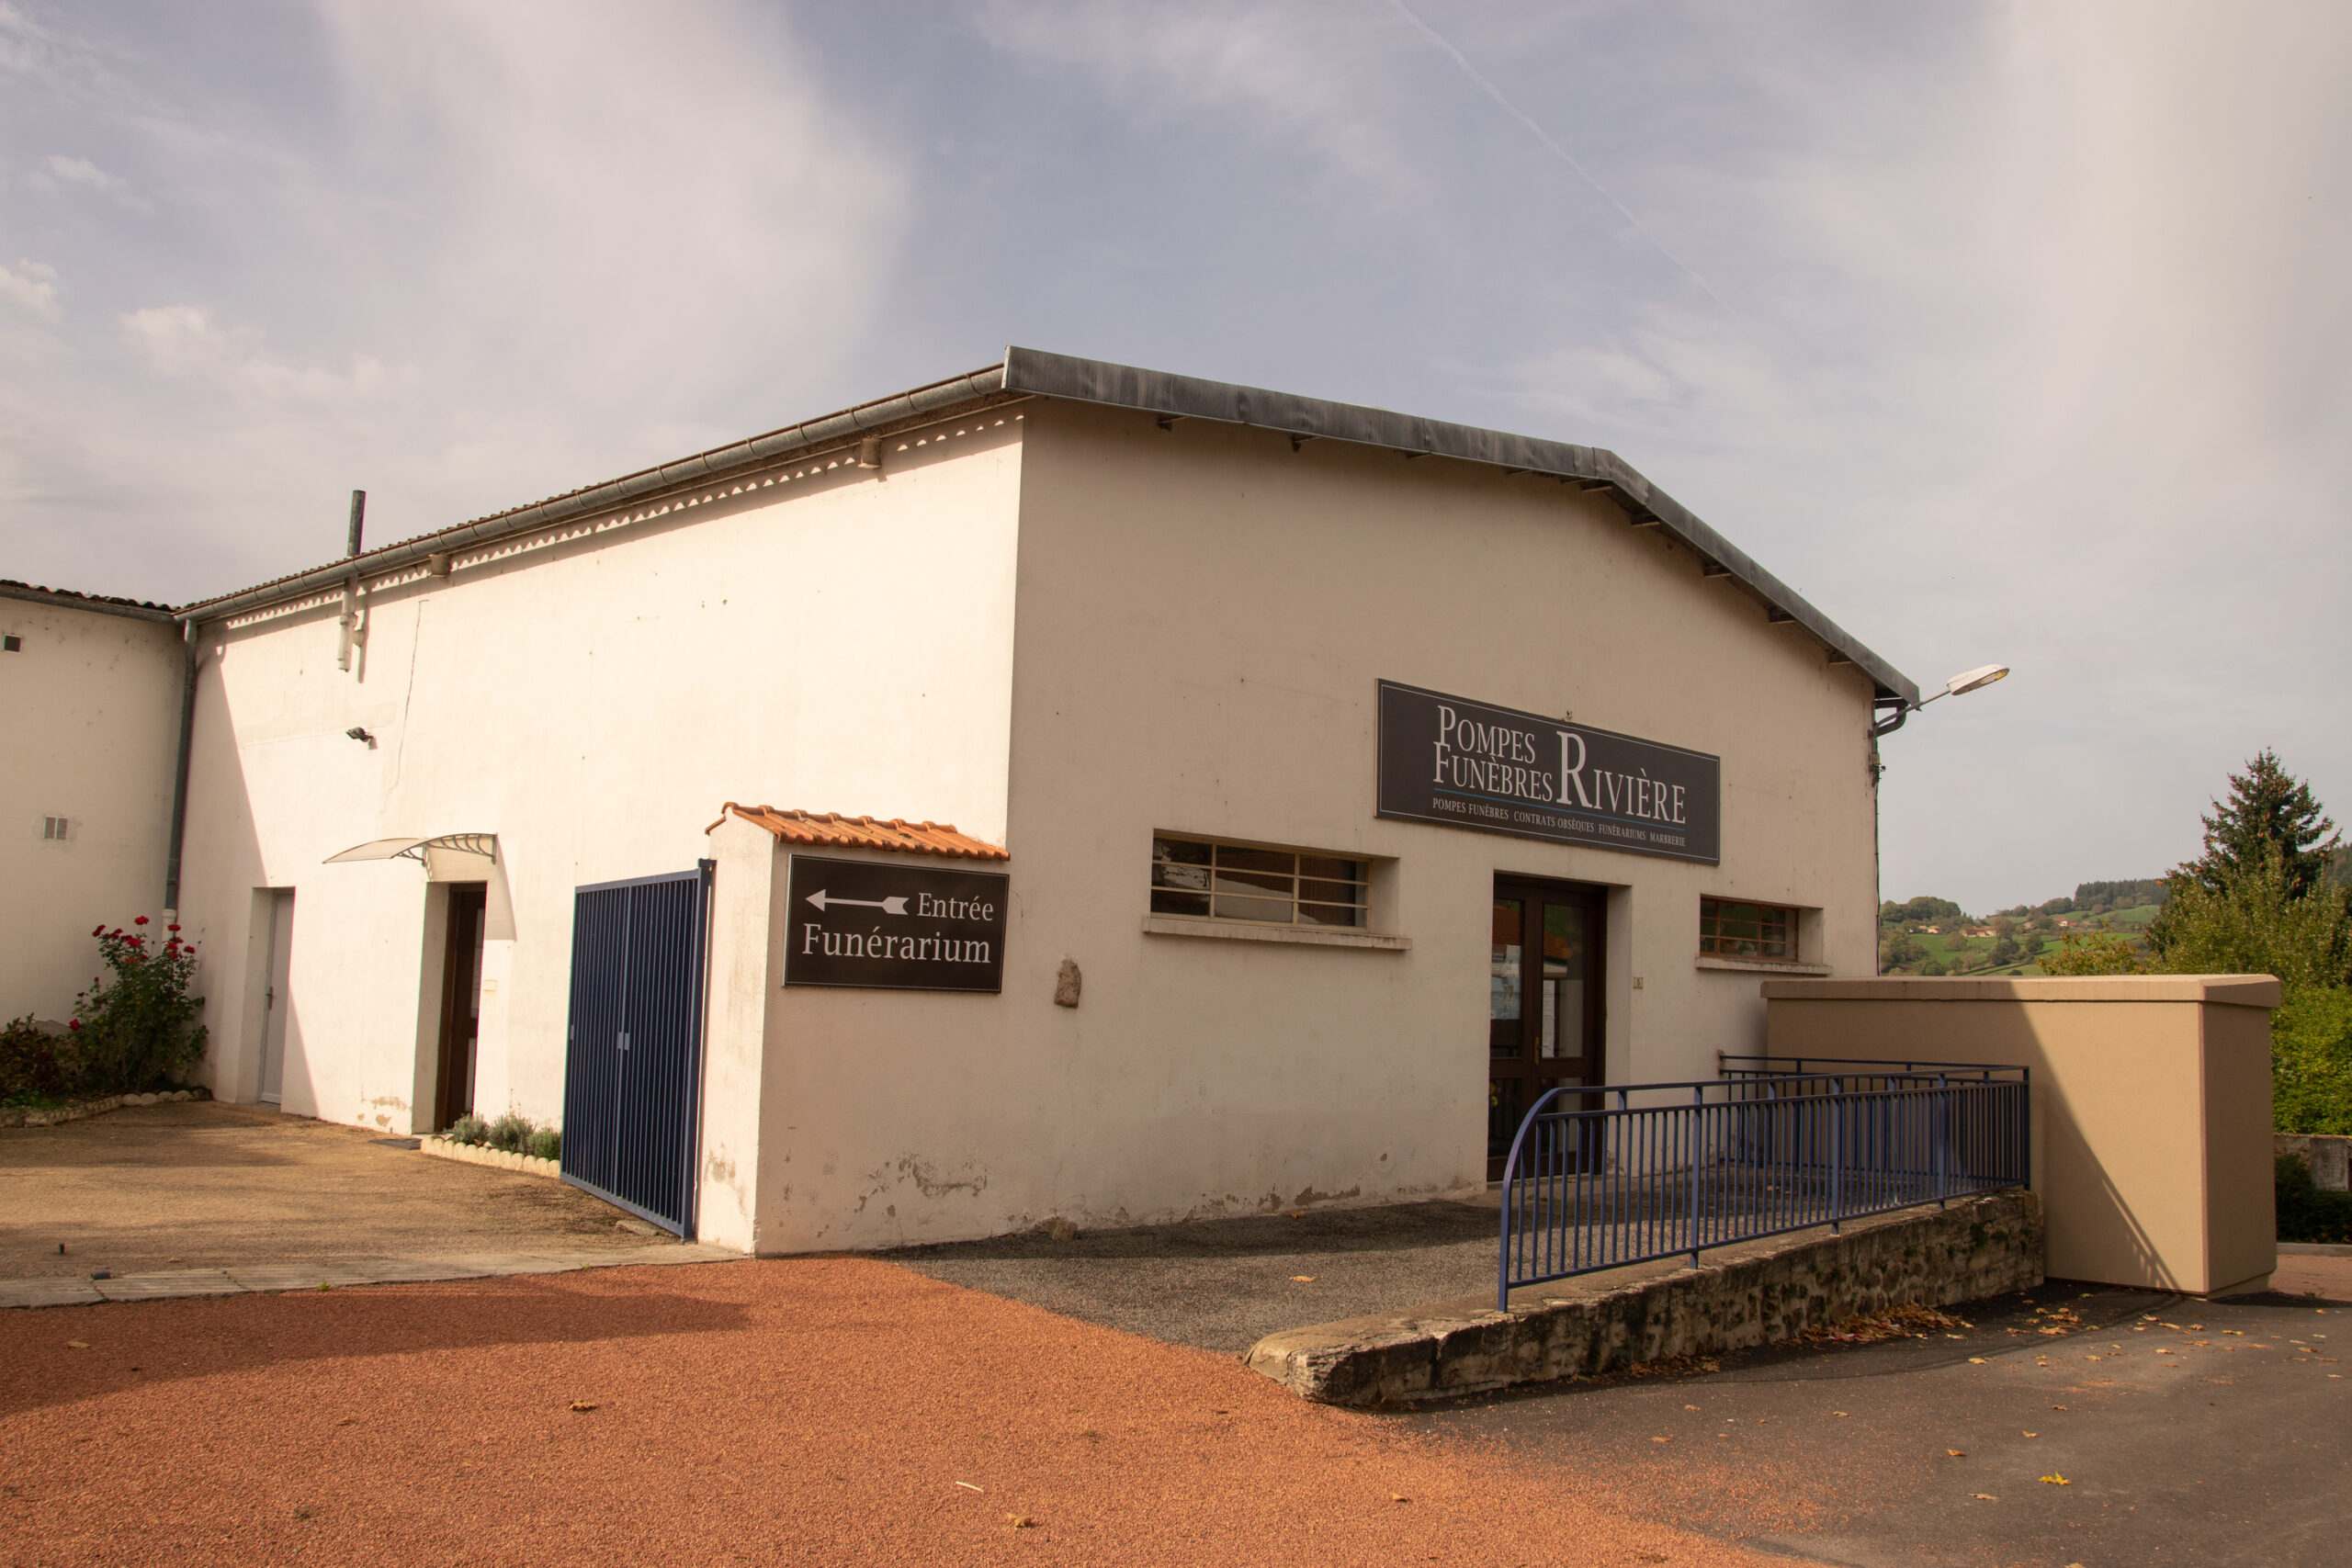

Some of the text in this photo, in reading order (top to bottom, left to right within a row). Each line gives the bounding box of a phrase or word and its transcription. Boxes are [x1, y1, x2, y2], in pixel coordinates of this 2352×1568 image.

[1437, 705, 1536, 764] POMPES
[1432, 741, 1553, 802] FUNÈBRES
[1556, 730, 1686, 824] RIVIÈRE
[1432, 797, 1466, 814] POMPES
[1513, 810, 1556, 828] CONTRATS
[1650, 831, 1686, 847] MARBRERIE
[917, 892, 994, 921] Entrée
[802, 922, 991, 964] Funérarium
